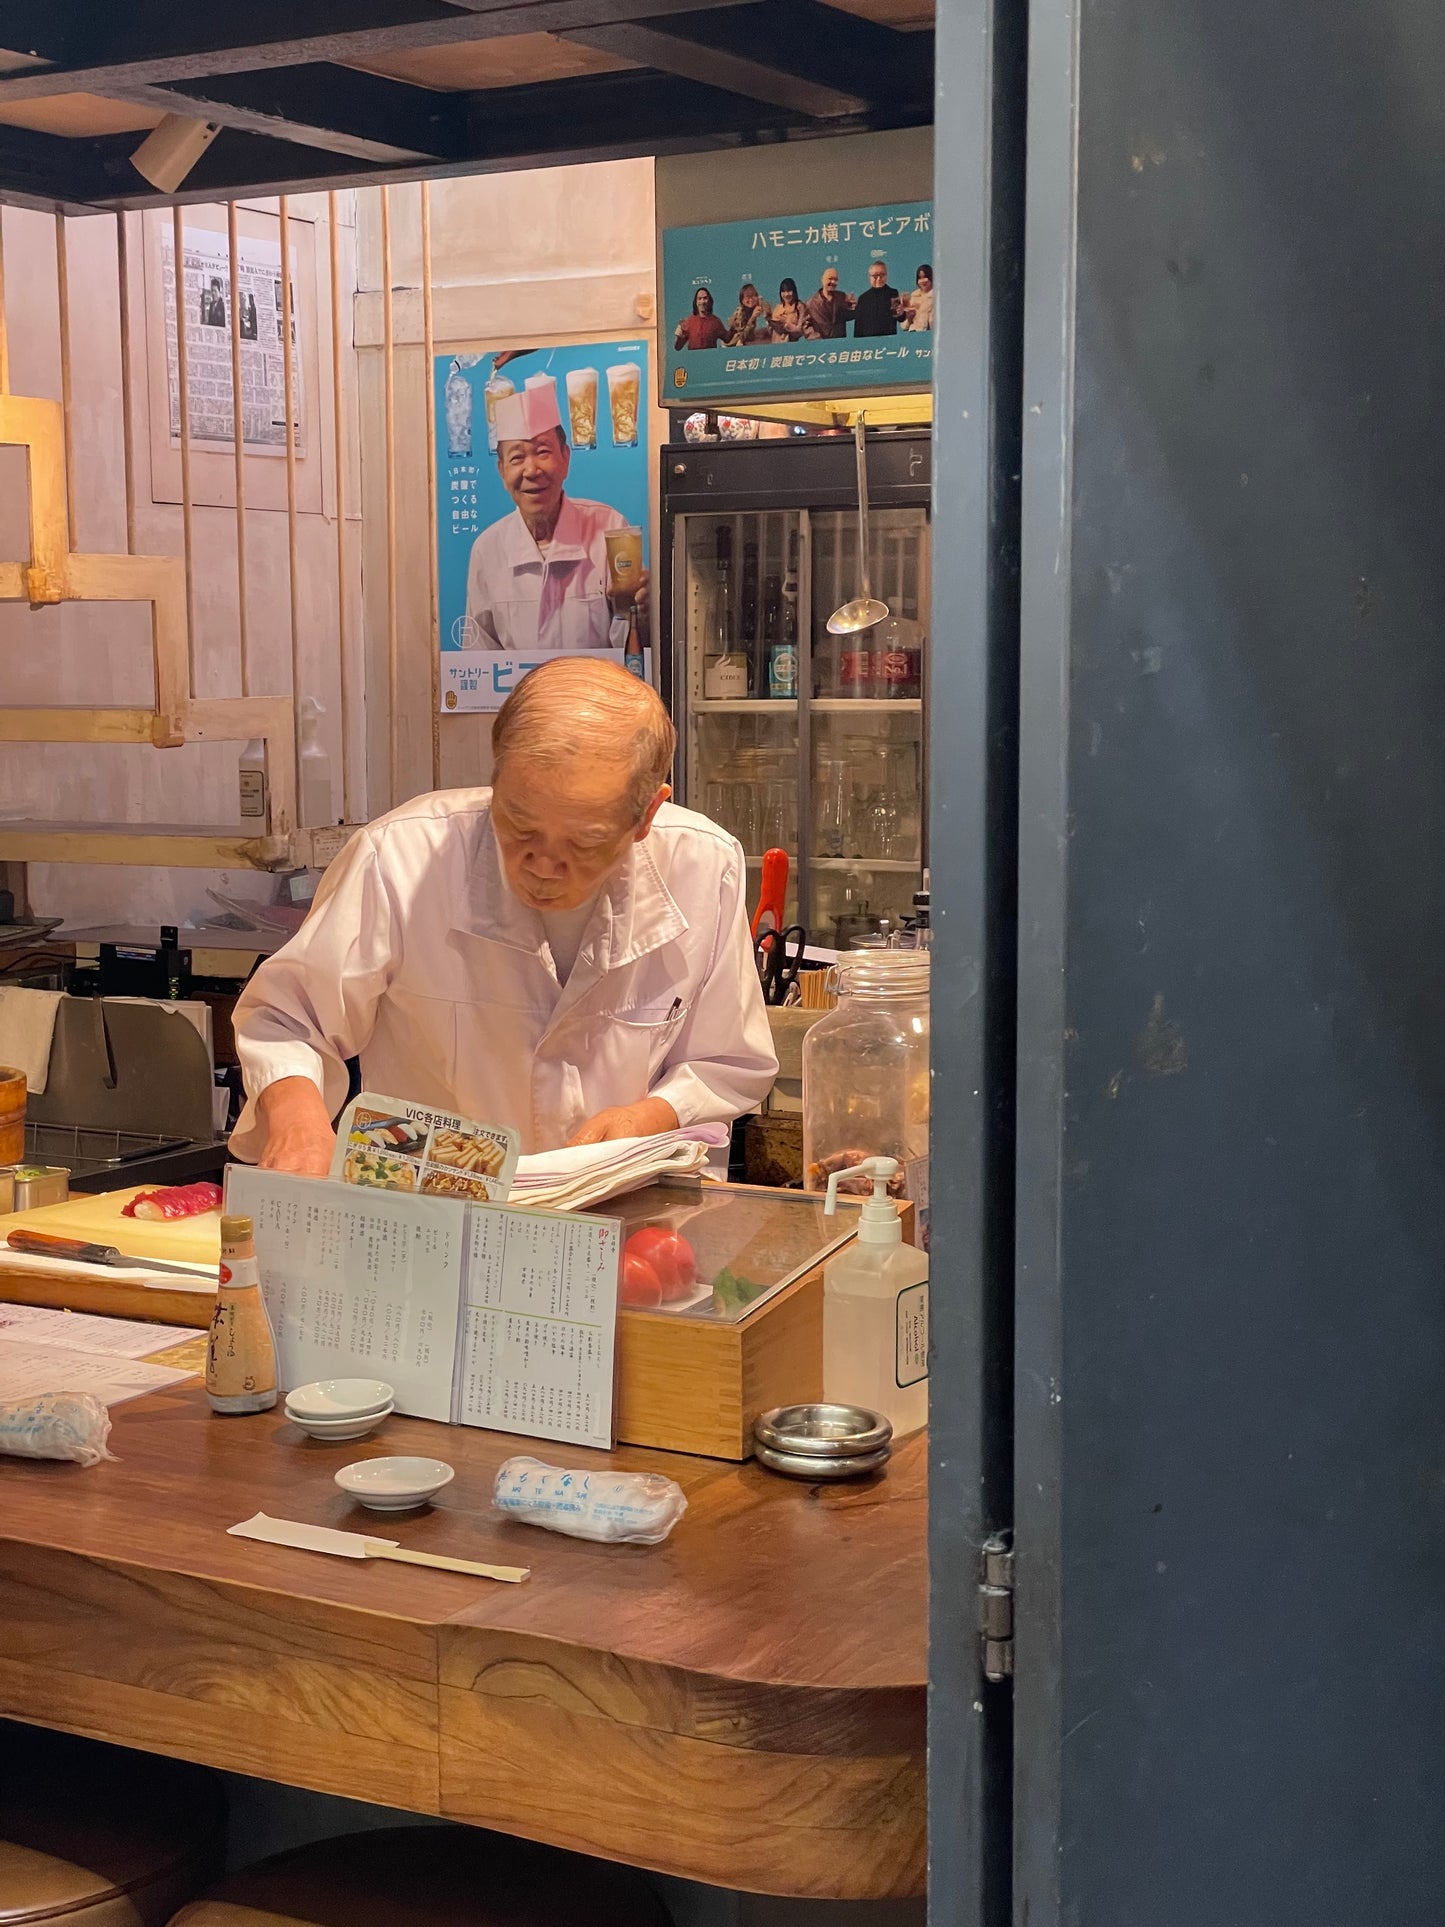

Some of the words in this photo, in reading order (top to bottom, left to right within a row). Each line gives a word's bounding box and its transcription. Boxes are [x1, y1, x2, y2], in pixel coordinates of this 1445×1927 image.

[751, 211, 931, 250] ハモニカ横丁でビアボ
[451, 494, 477, 504] つくる
[452, 510, 478, 520] 自由な
[452, 524, 479, 534] ビール
[449, 667, 489, 679] サントリー
[405, 1107, 462, 1131] VIC各店料理
[442, 1231, 450, 1271] ドリンク
